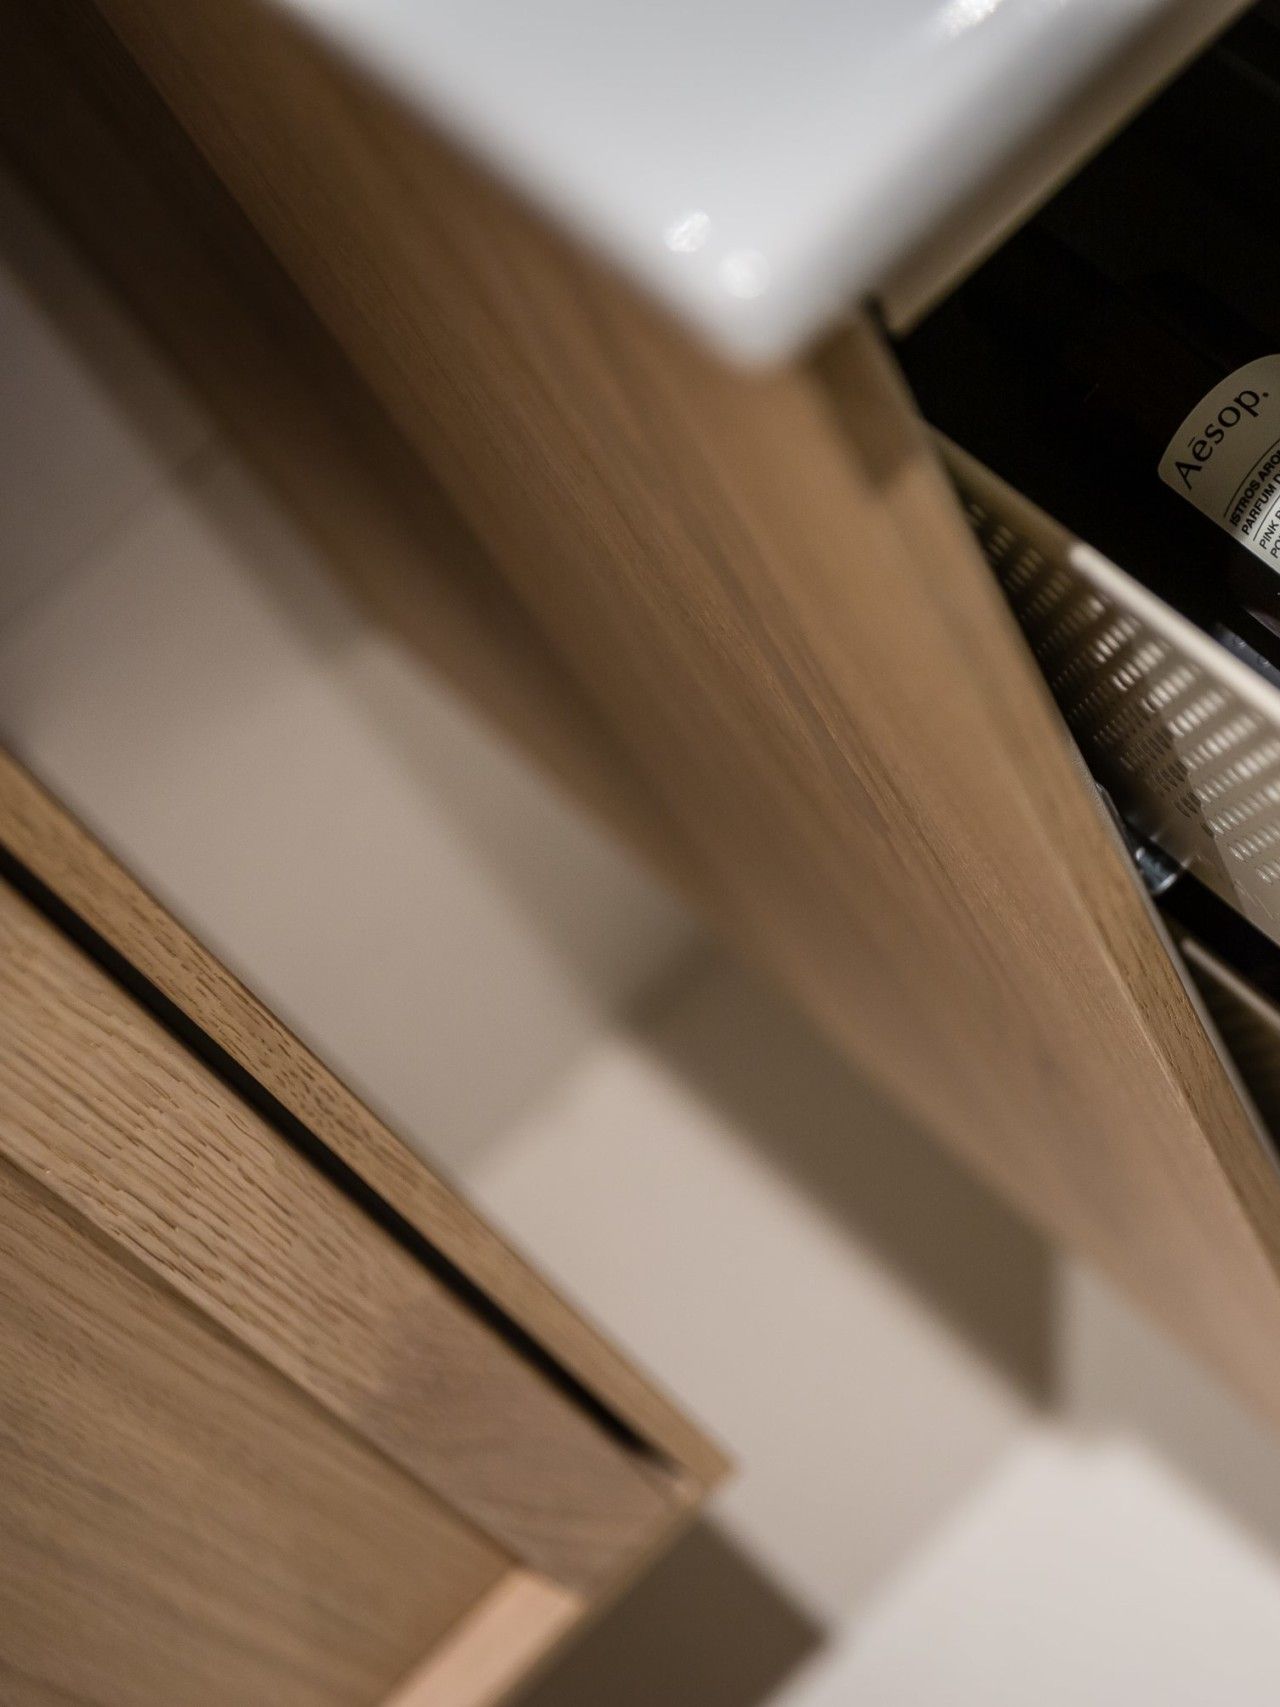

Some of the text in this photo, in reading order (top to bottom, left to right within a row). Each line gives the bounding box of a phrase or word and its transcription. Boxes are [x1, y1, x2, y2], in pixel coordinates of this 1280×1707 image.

[1229, 479, 1261, 527] ISTROS
[1241, 483, 1277, 536] PARFUM
[1258, 518, 1280, 550] PINK
